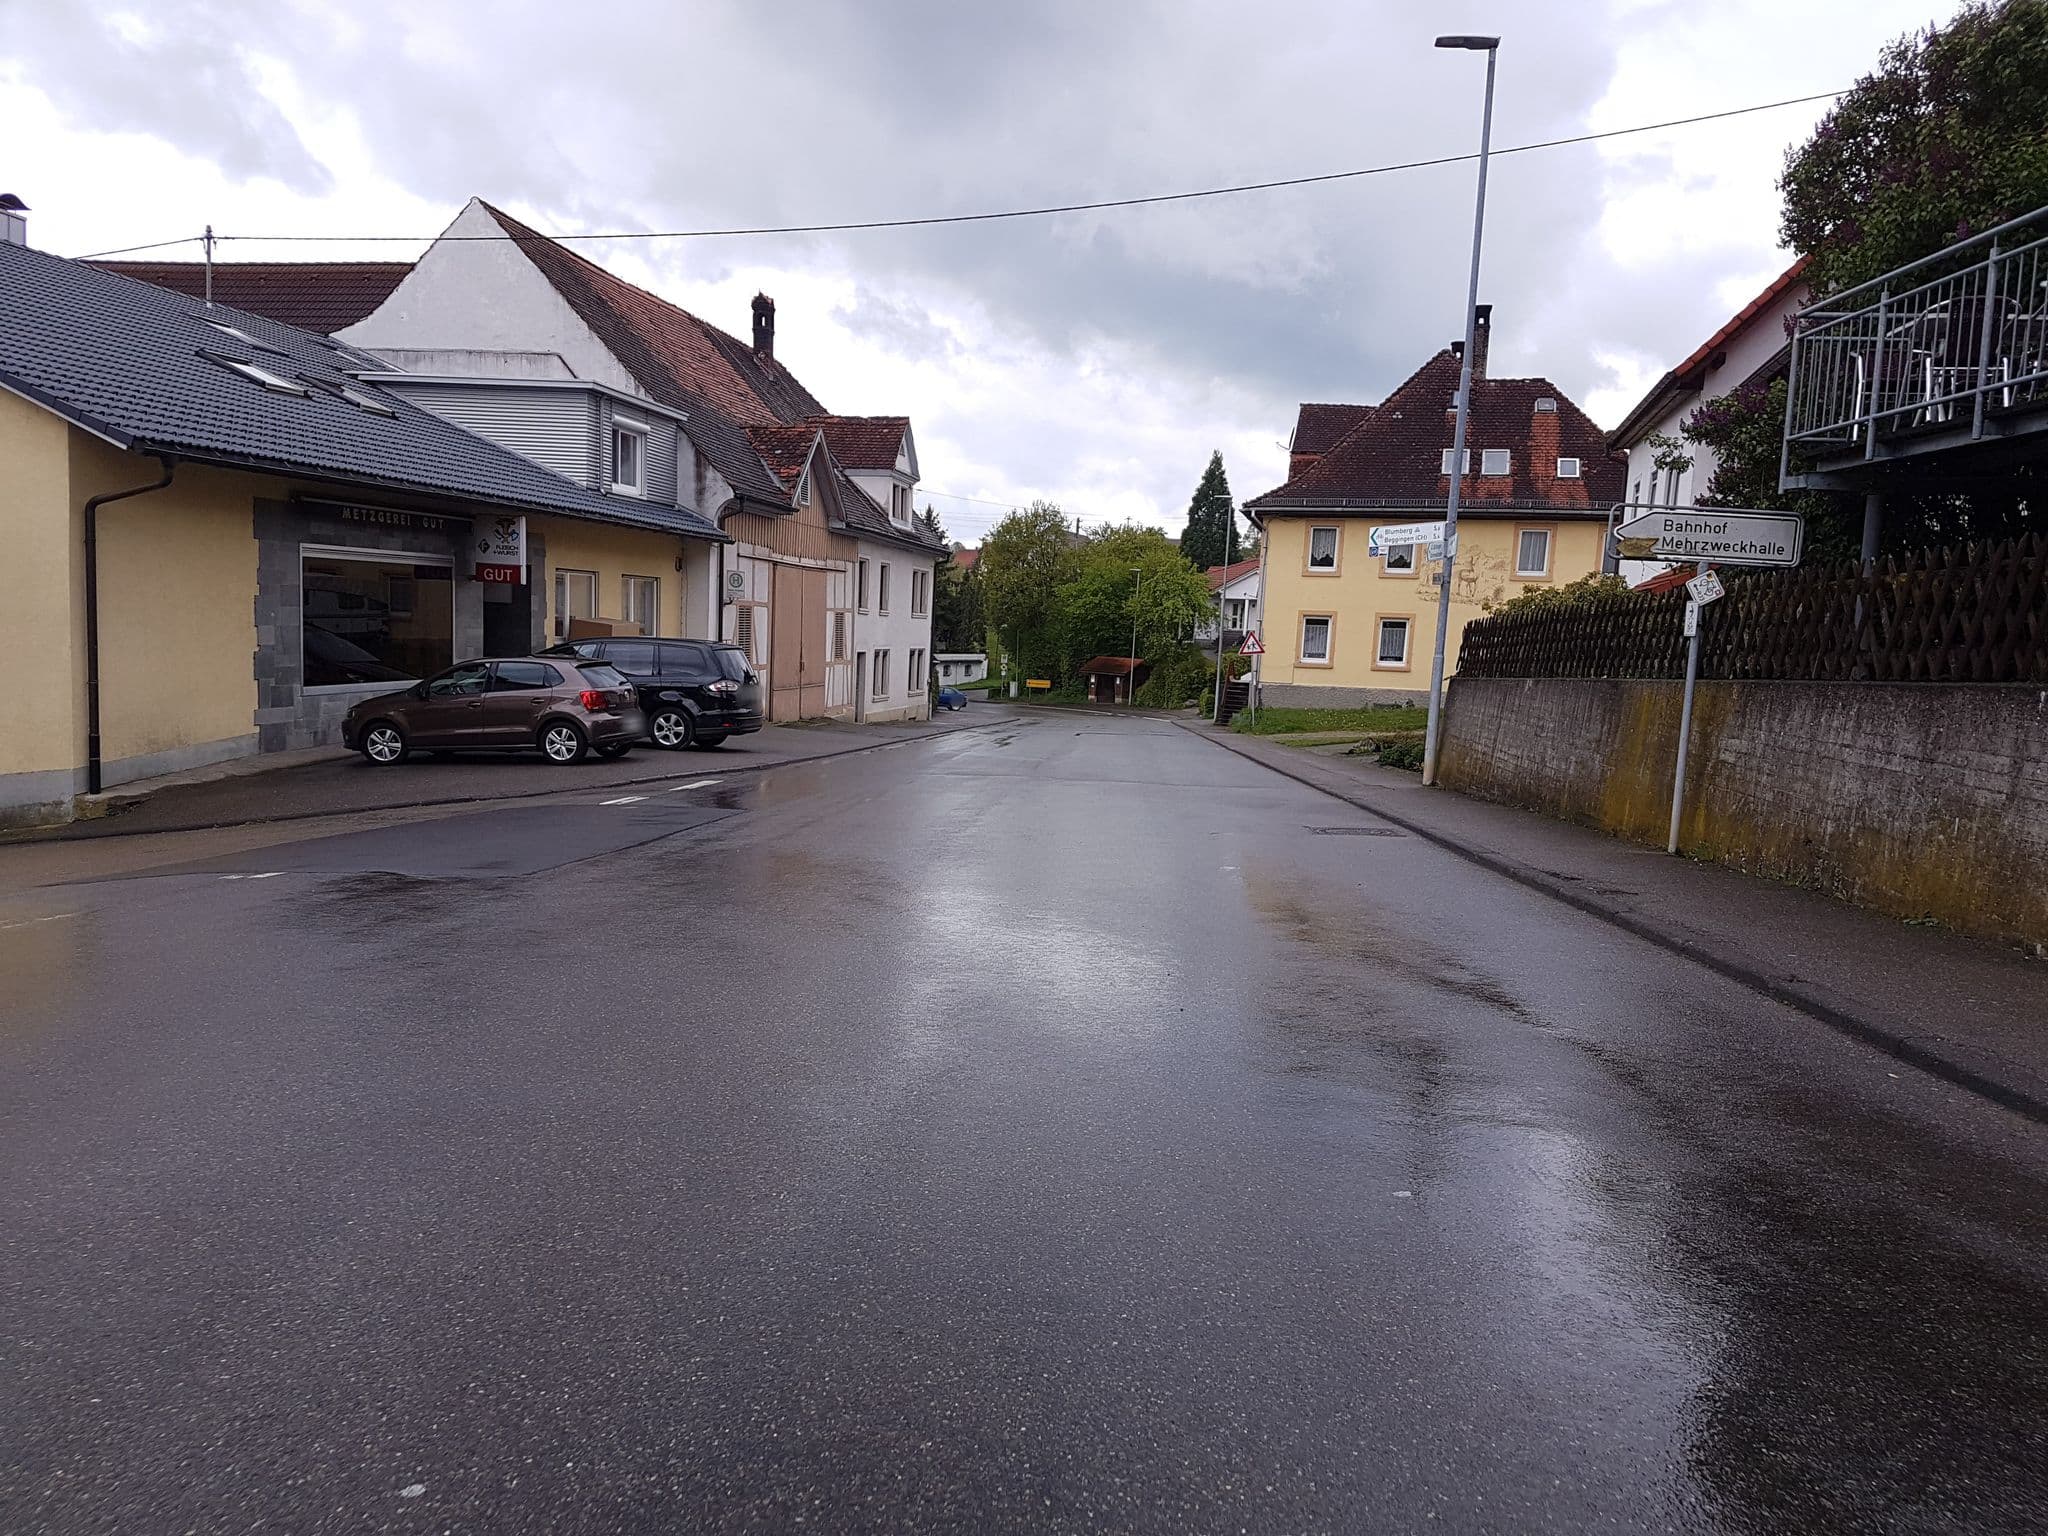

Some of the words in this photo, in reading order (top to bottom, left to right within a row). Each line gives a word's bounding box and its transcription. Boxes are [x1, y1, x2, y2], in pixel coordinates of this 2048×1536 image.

[342, 507, 411, 526] METZGEREI
[423, 517, 444, 529] GUT
[1384, 527, 1413, 535] Blumberg
[1663, 519, 1728, 535] Bahnhof
[1661, 537, 1785, 556] Mehrzweckhalle
[483, 568, 513, 582] GUT
